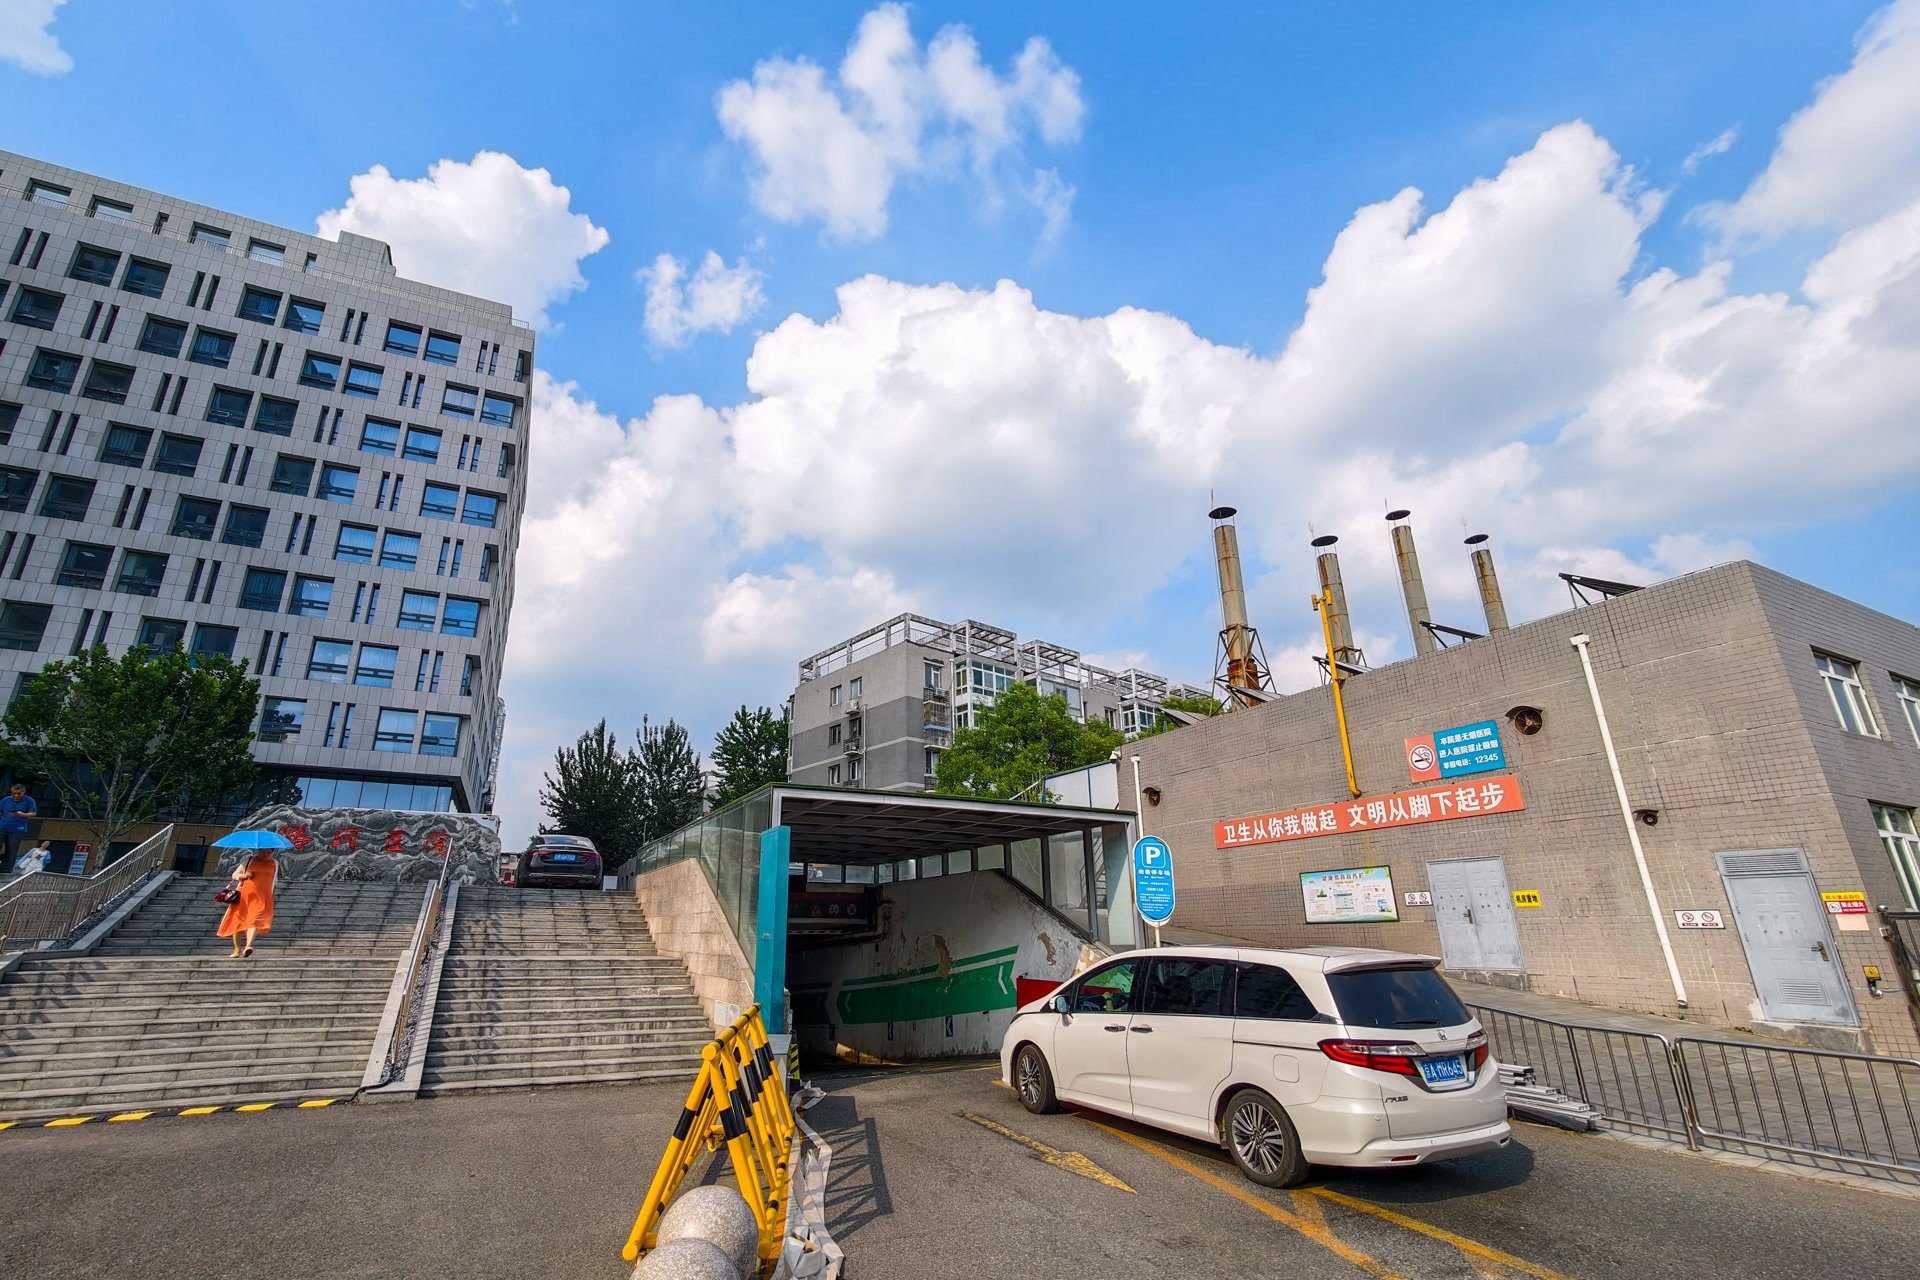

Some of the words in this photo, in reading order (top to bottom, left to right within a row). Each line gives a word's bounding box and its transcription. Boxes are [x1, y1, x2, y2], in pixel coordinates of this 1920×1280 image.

[1440, 728, 1492, 745] 本院是无烟医院
[1439, 739, 1499, 758] 进入医院禁止吸烟
[1475, 753, 1499, 764] 12345
[1223, 809, 1338, 844] 卫生从你我做起
[1346, 782, 1505, 828] 文明从脚下起步
[1145, 846, 1161, 865] P
